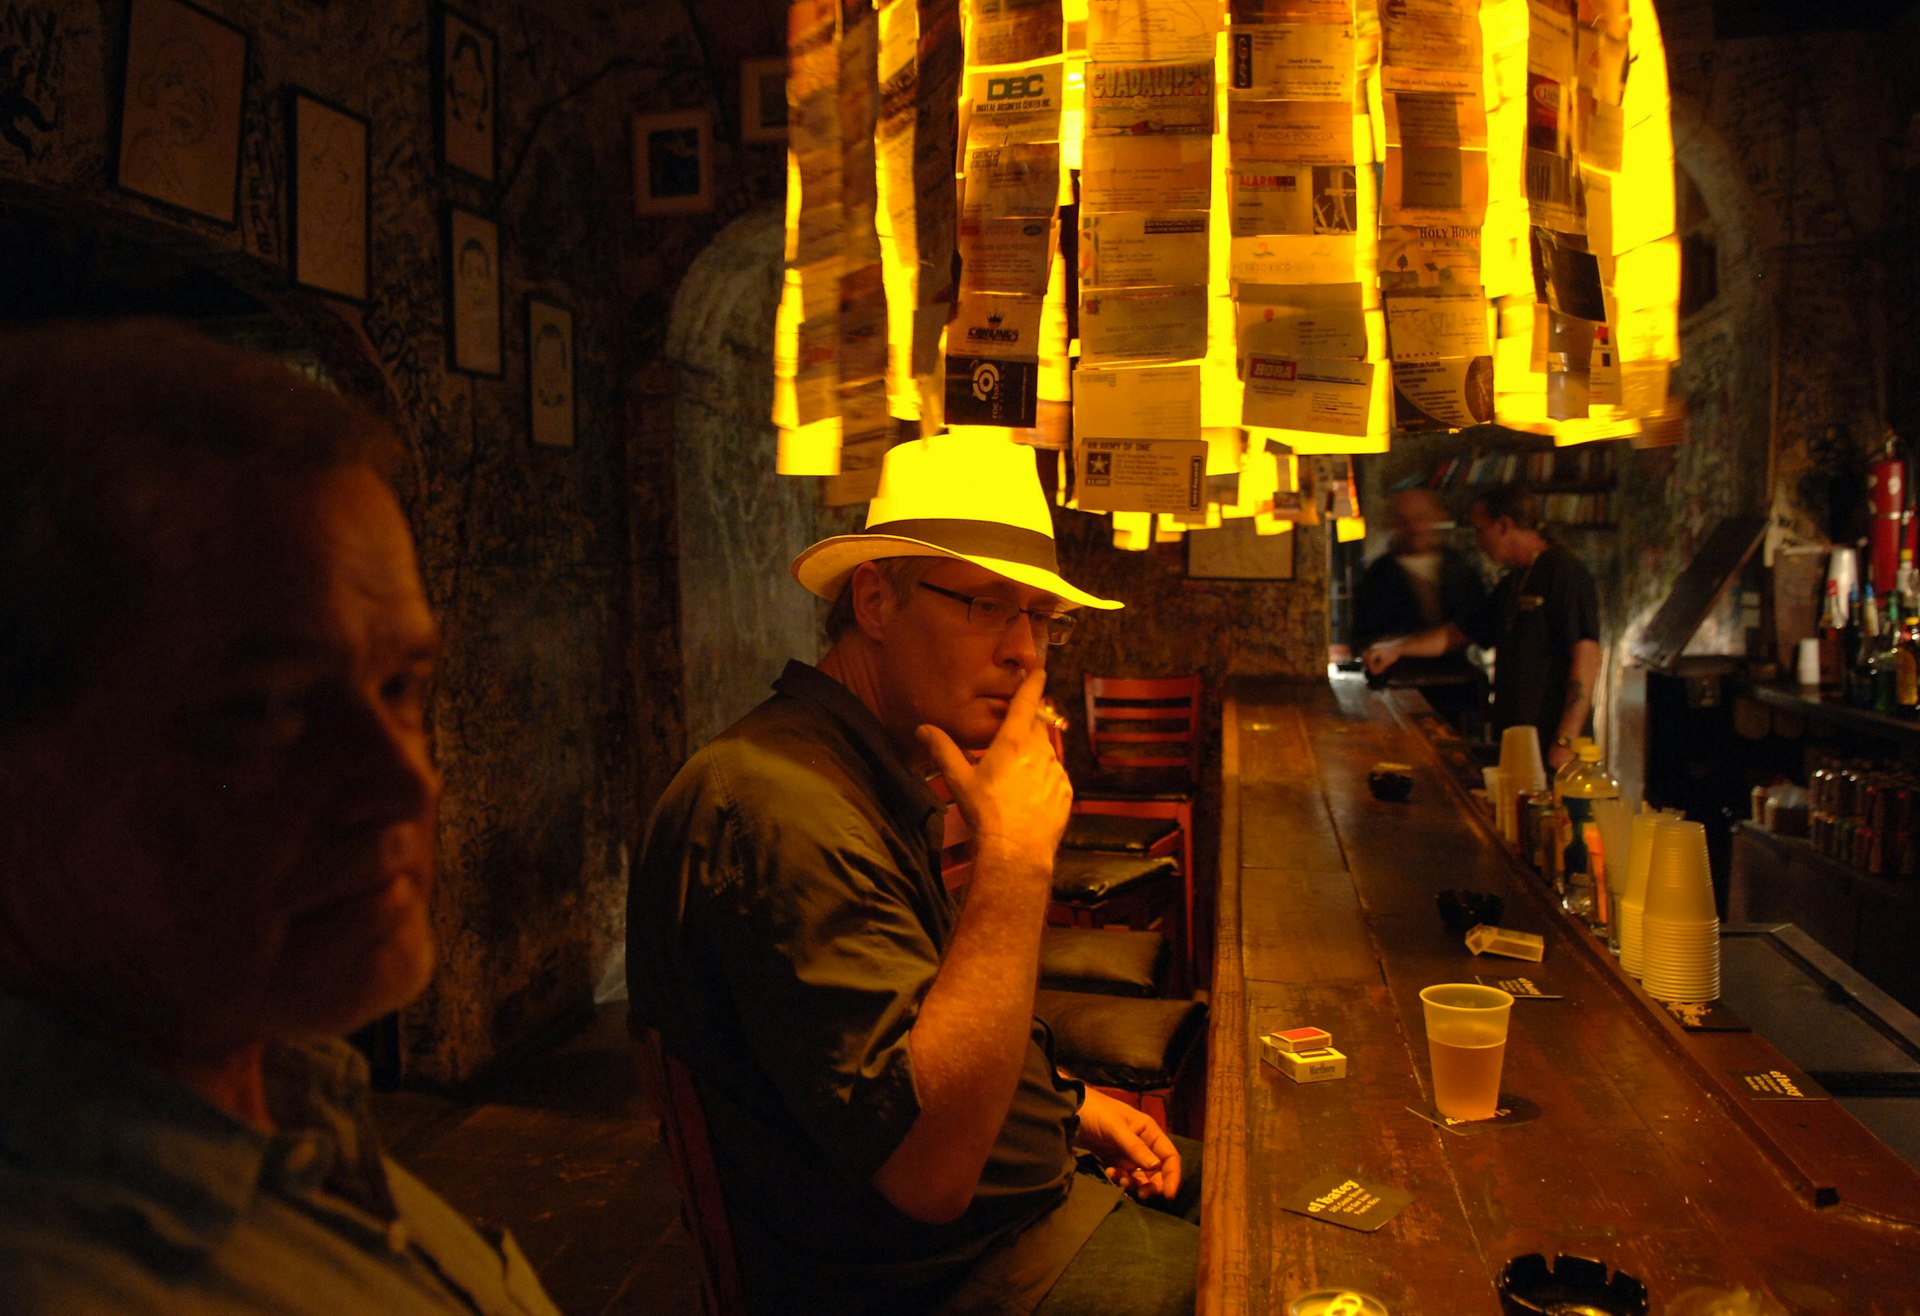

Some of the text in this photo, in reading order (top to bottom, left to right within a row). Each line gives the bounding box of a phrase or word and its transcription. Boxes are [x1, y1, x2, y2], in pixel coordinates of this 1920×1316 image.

[987, 74, 1044, 101] DBC
[1420, 226, 1449, 239] HOLY
[1100, 442, 1121, 451] ARMY
[1307, 1179, 1360, 1213] el batey
